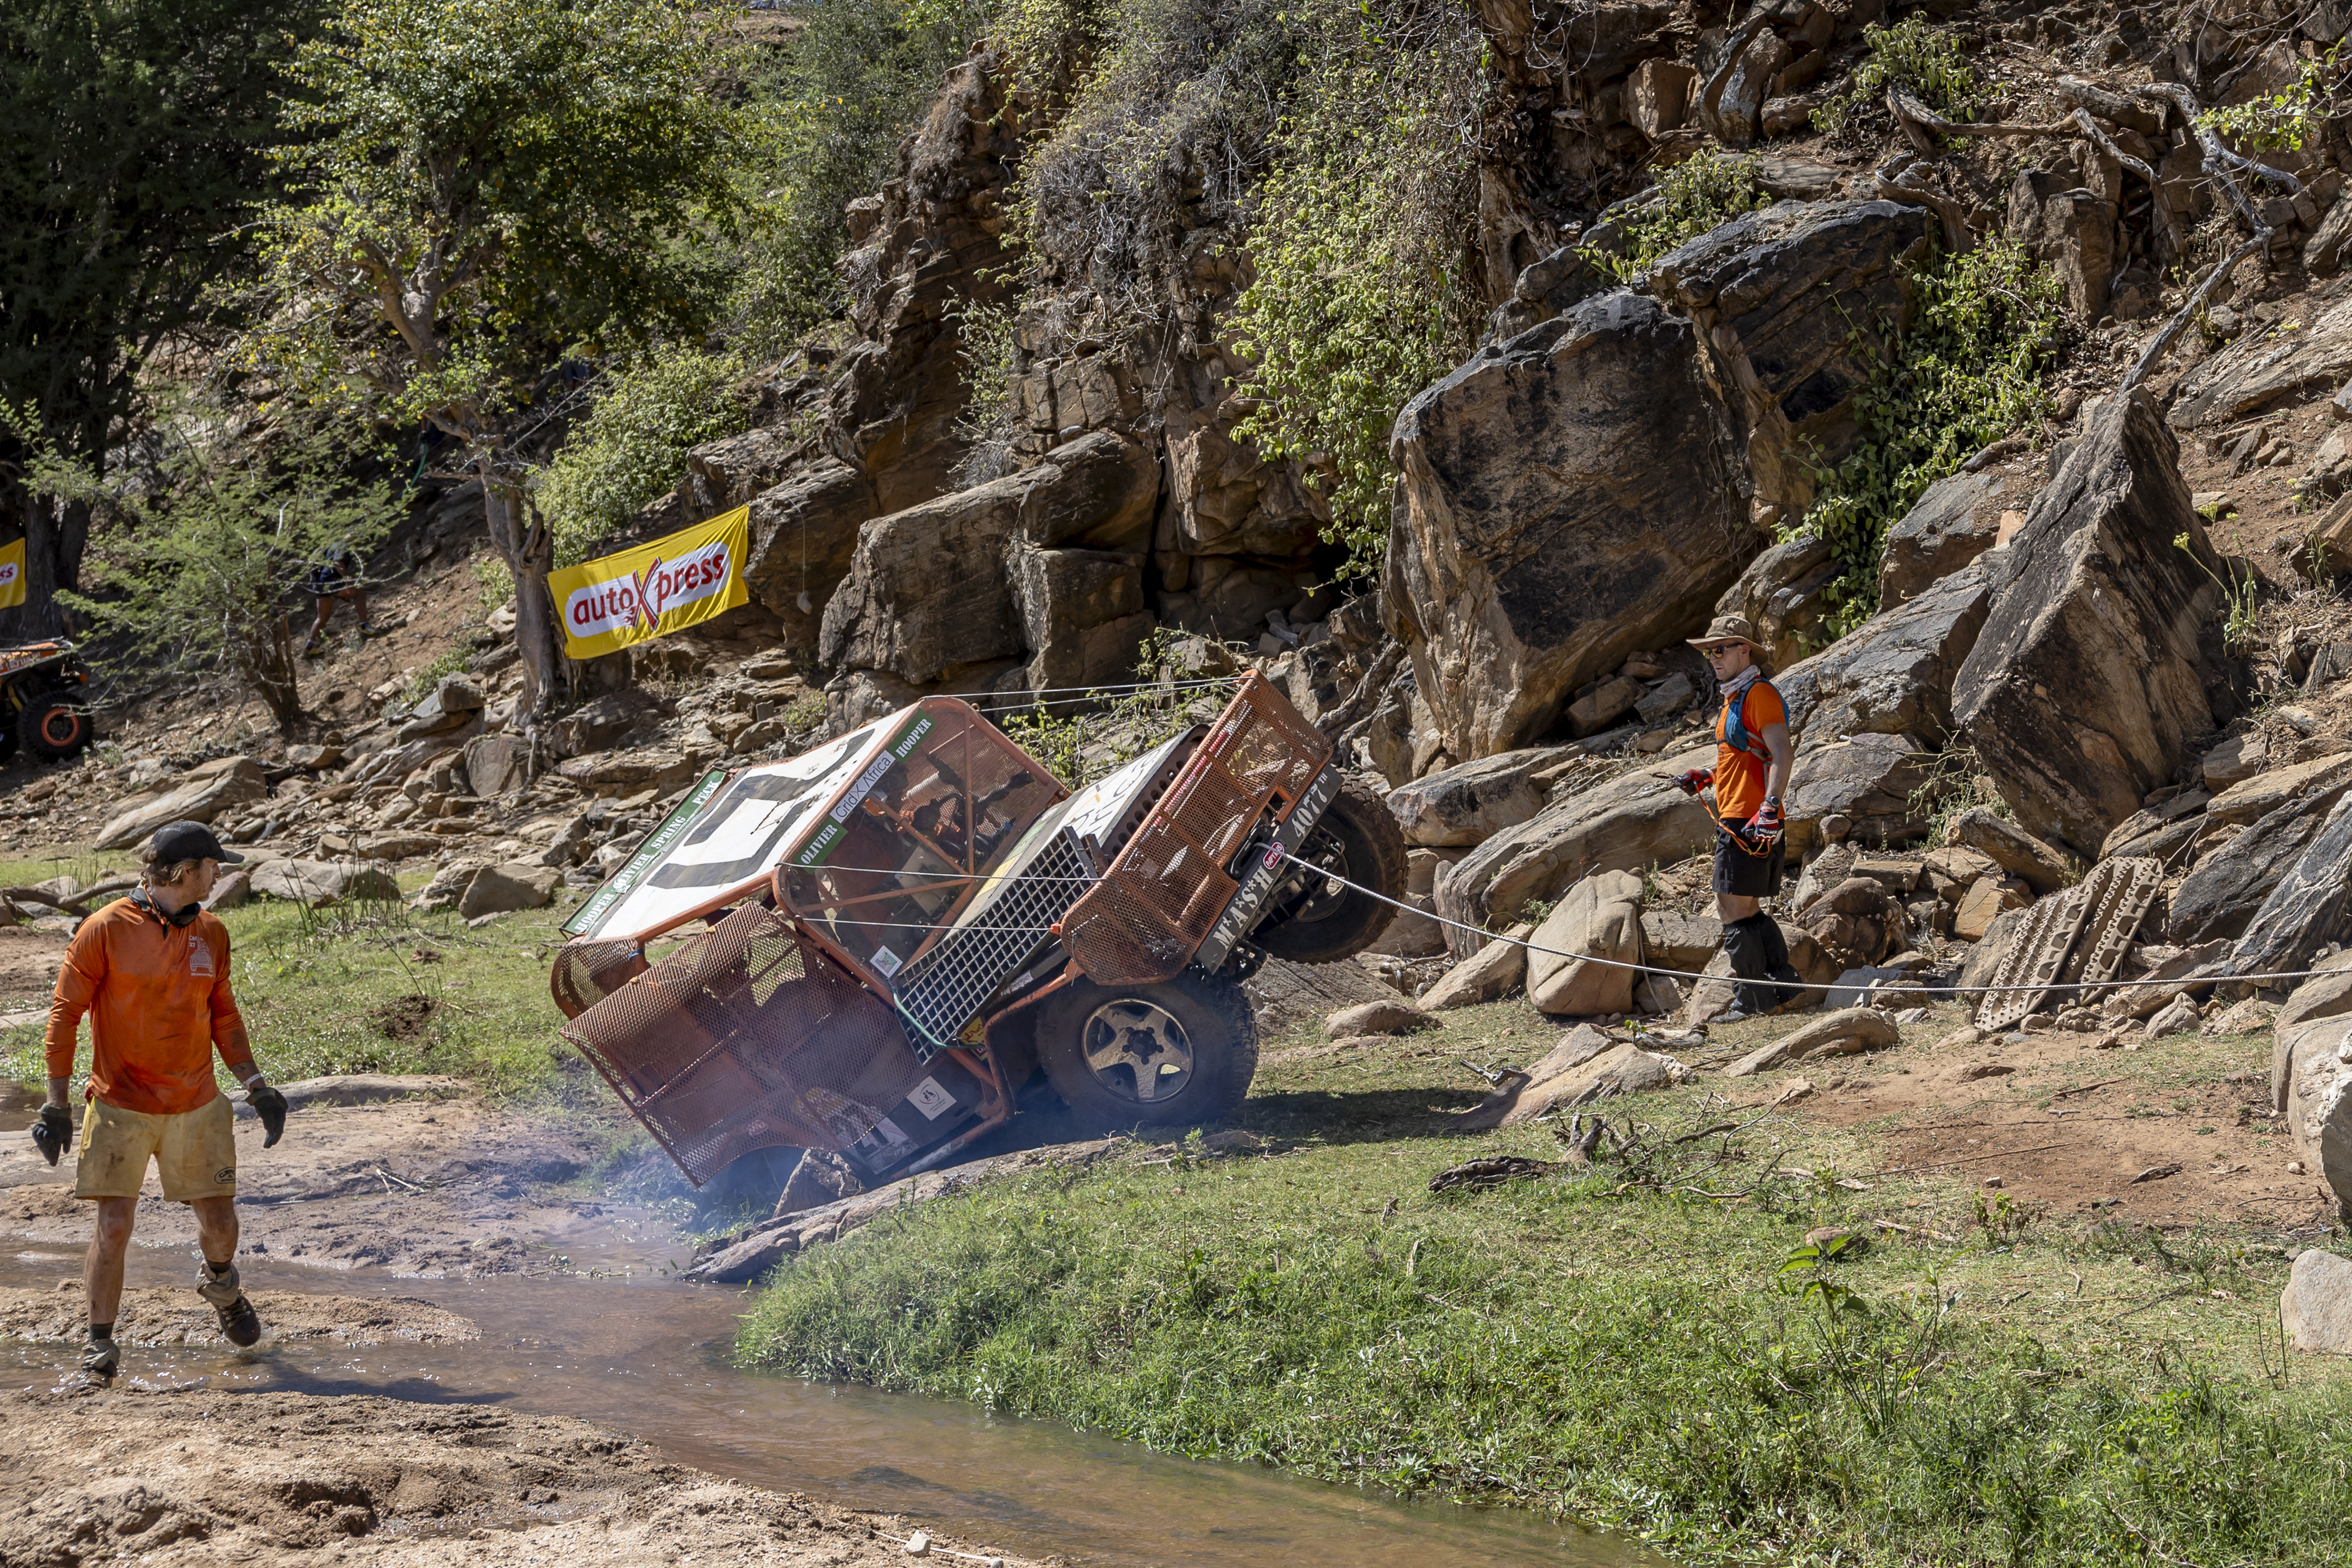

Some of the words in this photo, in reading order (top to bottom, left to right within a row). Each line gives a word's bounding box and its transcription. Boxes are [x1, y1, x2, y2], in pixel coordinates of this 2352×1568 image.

[573, 554, 725, 631] autoXpress
[895, 718, 932, 758] HOOPER
[836, 784, 866, 818] GridX
[863, 756, 892, 788] Africa
[574, 893, 615, 932] HOOPER
[613, 853, 652, 890] OLIVIER
[651, 816, 686, 849] SPRING
[692, 781, 719, 805] PECK
[801, 824, 838, 864] OLIVIER
